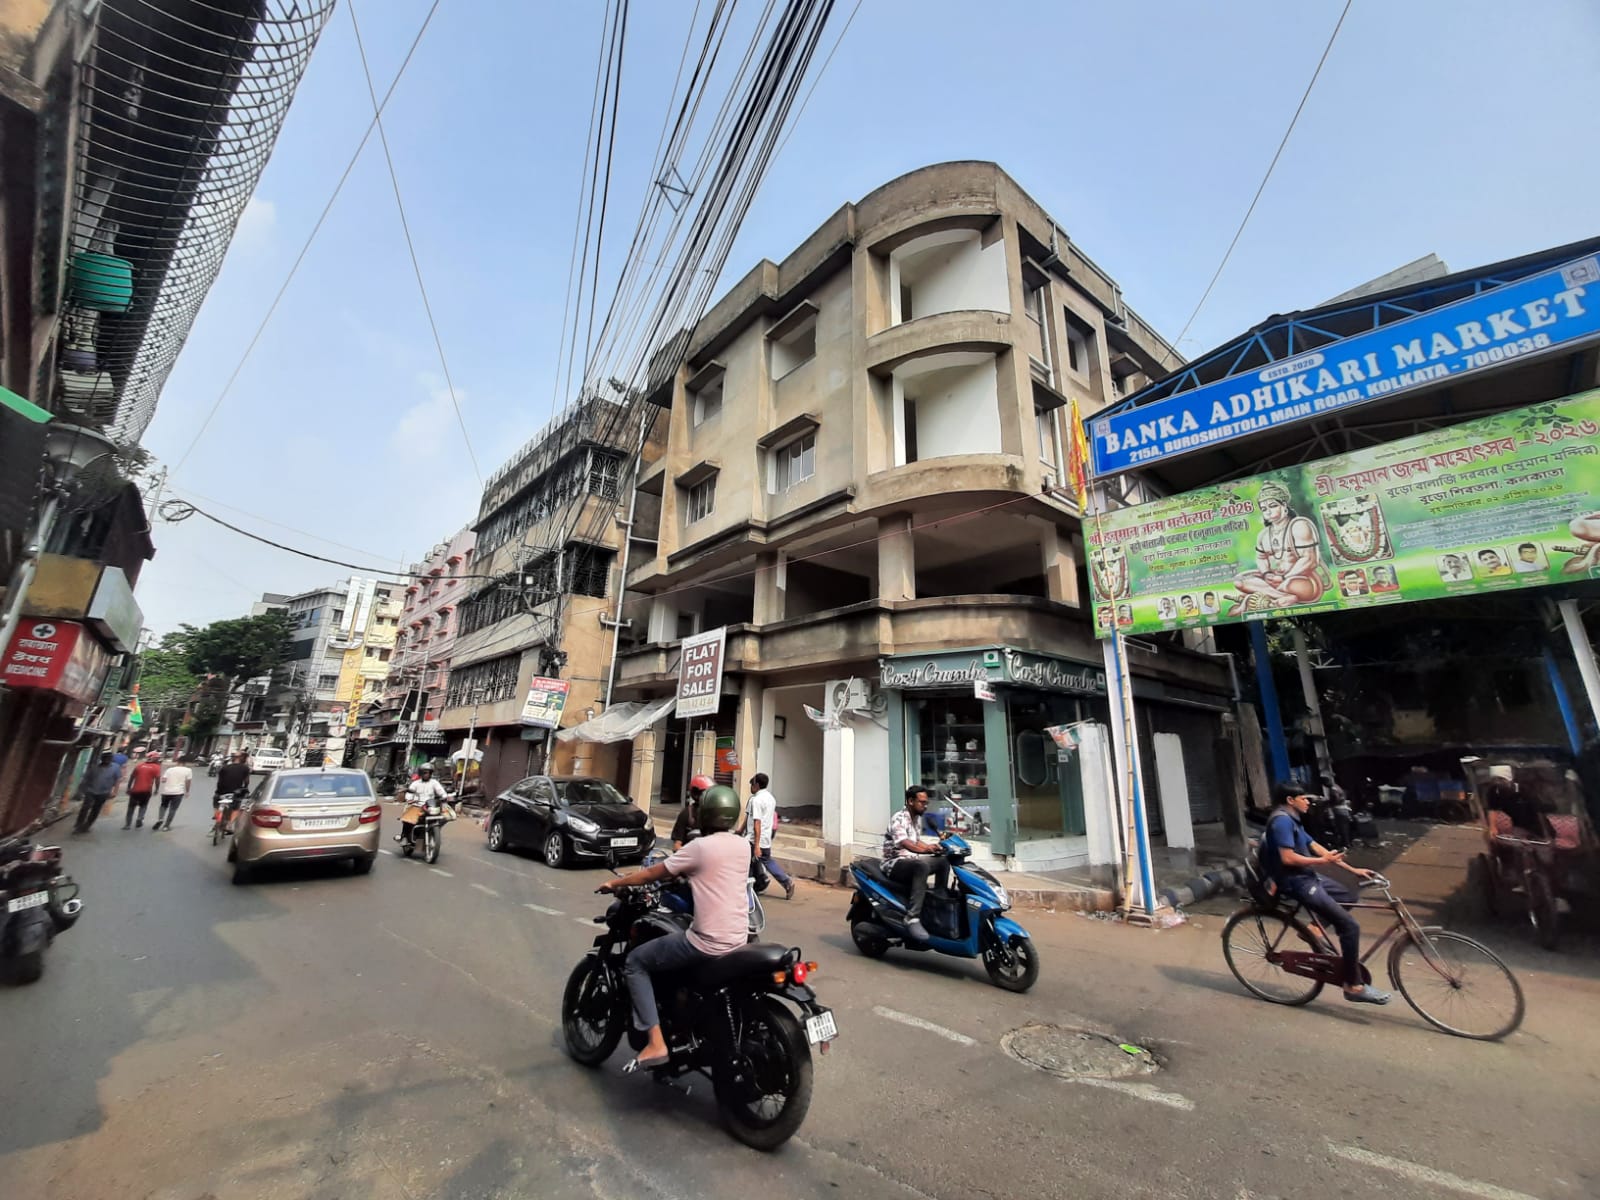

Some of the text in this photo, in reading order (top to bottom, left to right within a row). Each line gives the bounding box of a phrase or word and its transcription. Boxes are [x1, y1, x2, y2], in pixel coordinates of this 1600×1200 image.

[1104, 287, 1586, 455] BANKA ADHIKARI MARKET
[1293, 358, 1315, 372] 2020
[1129, 444, 1163, 463] 215A,
[1164, 415, 1269, 454] BUROSHIBTOLA
[1270, 402, 1311, 423] MAIN
[1366, 363, 1450, 397] KOLKATA
[1462, 333, 1551, 369] 700038
[1315, 474, 1335, 497] শ্রী
[1336, 466, 1389, 491] হনুমান
[1390, 458, 1430, 479] জন্ম
[1430, 437, 1516, 469] মহোৎসব
[1534, 420, 1598, 445] ২০২৬
[1460, 465, 1499, 481] দরবার
[1504, 468, 1565, 486] কলকাতা
[1219, 500, 1254, 518] 2026
[685, 643, 718, 663] FLAT
[5, 664, 48, 677] MEDICINE
[686, 661, 712, 680] FOR
[881, 659, 988, 686] Cozy Crumbs
[1009, 653, 1046, 686] Cozy
[682, 679, 714, 697] SALE
